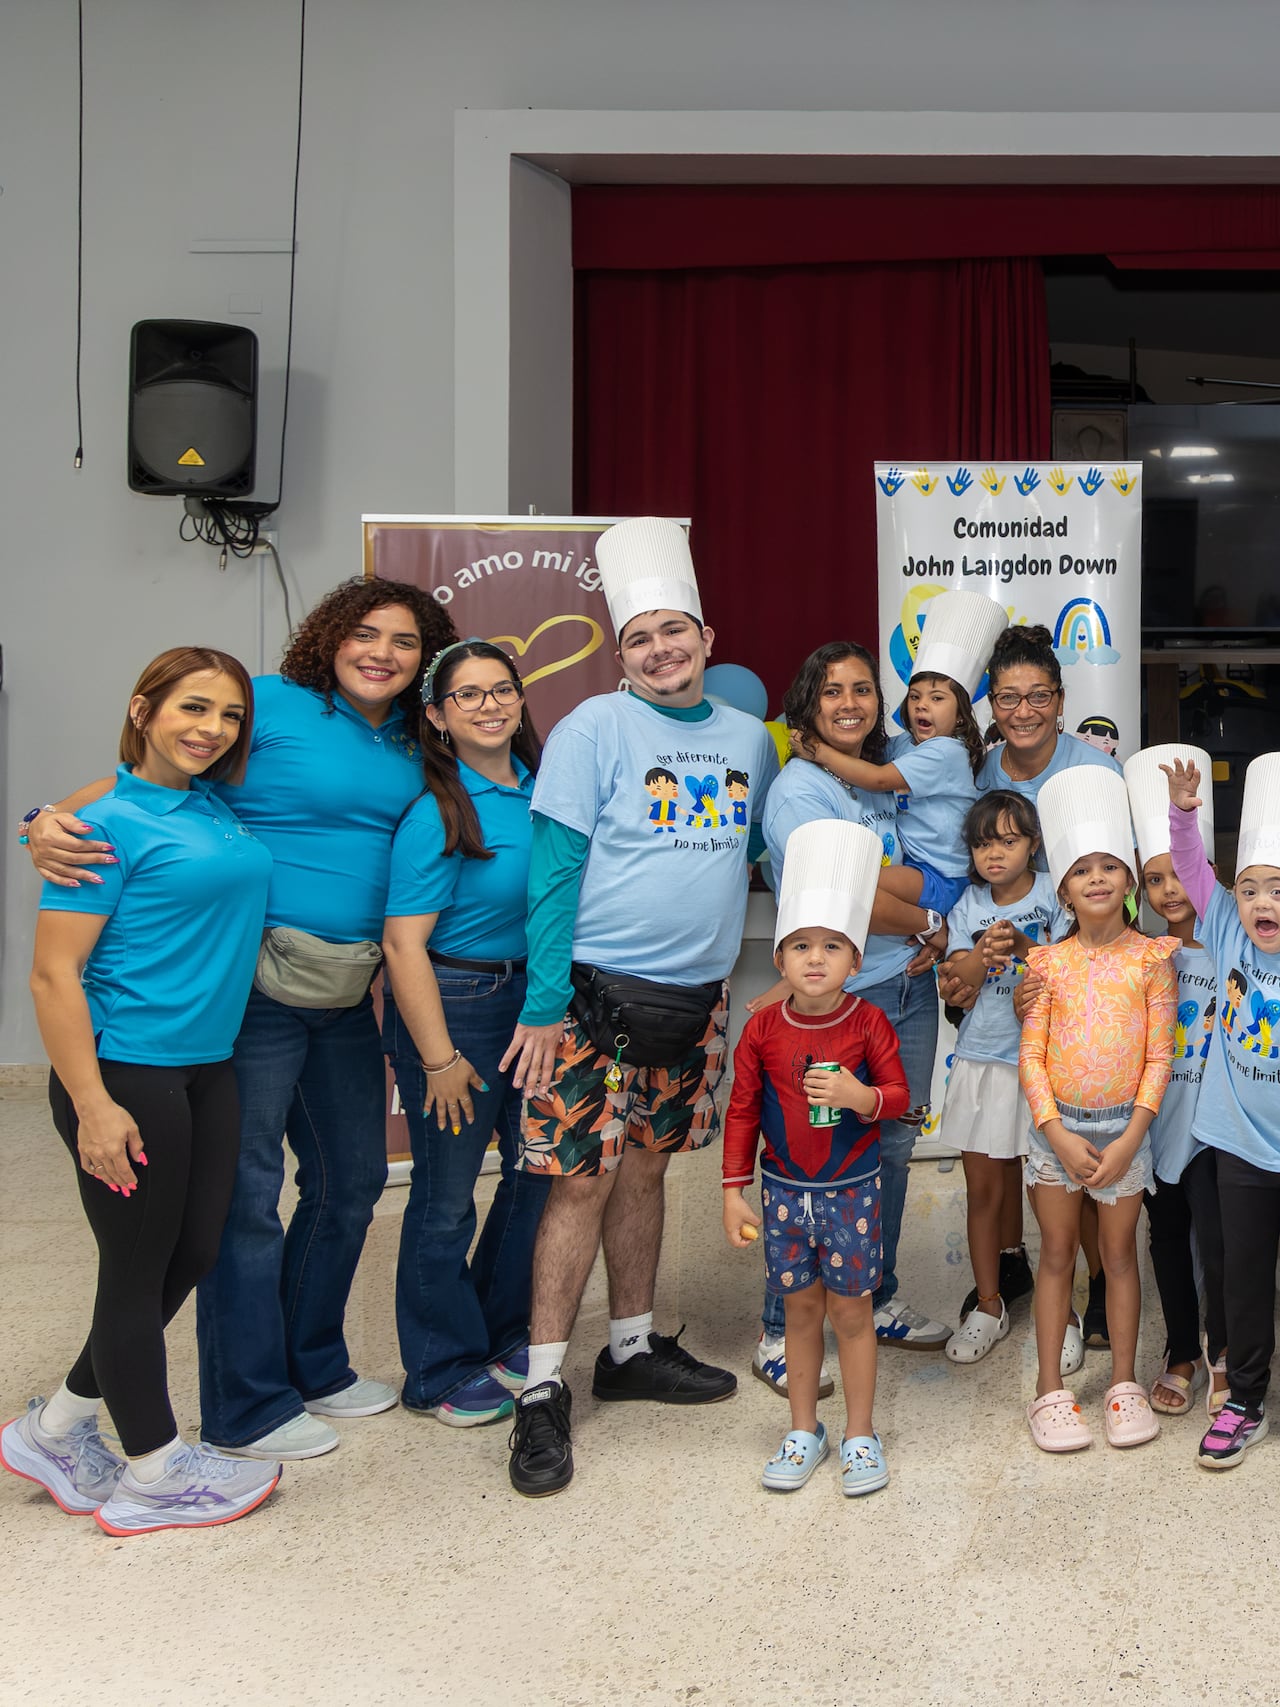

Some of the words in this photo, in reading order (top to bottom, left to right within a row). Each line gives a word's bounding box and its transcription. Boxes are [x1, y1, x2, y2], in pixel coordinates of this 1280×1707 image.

[953, 516, 1068, 538] Comunidad
[902, 556, 954, 576] John
[962, 554, 1051, 583] Langdon
[1059, 554, 1117, 575] Down
[432, 585, 454, 604] o
[454, 551, 523, 588] amo
[531, 550, 574, 573] mi
[574, 557, 604, 592] ig
[676, 751, 729, 765] diferente
[674, 838, 689, 849] no
[692, 839, 709, 851] me
[711, 837, 740, 852] limita
[996, 986, 1010, 995] no
[1169, 1068, 1202, 1084] imita
[1236, 1062, 1250, 1077] me
